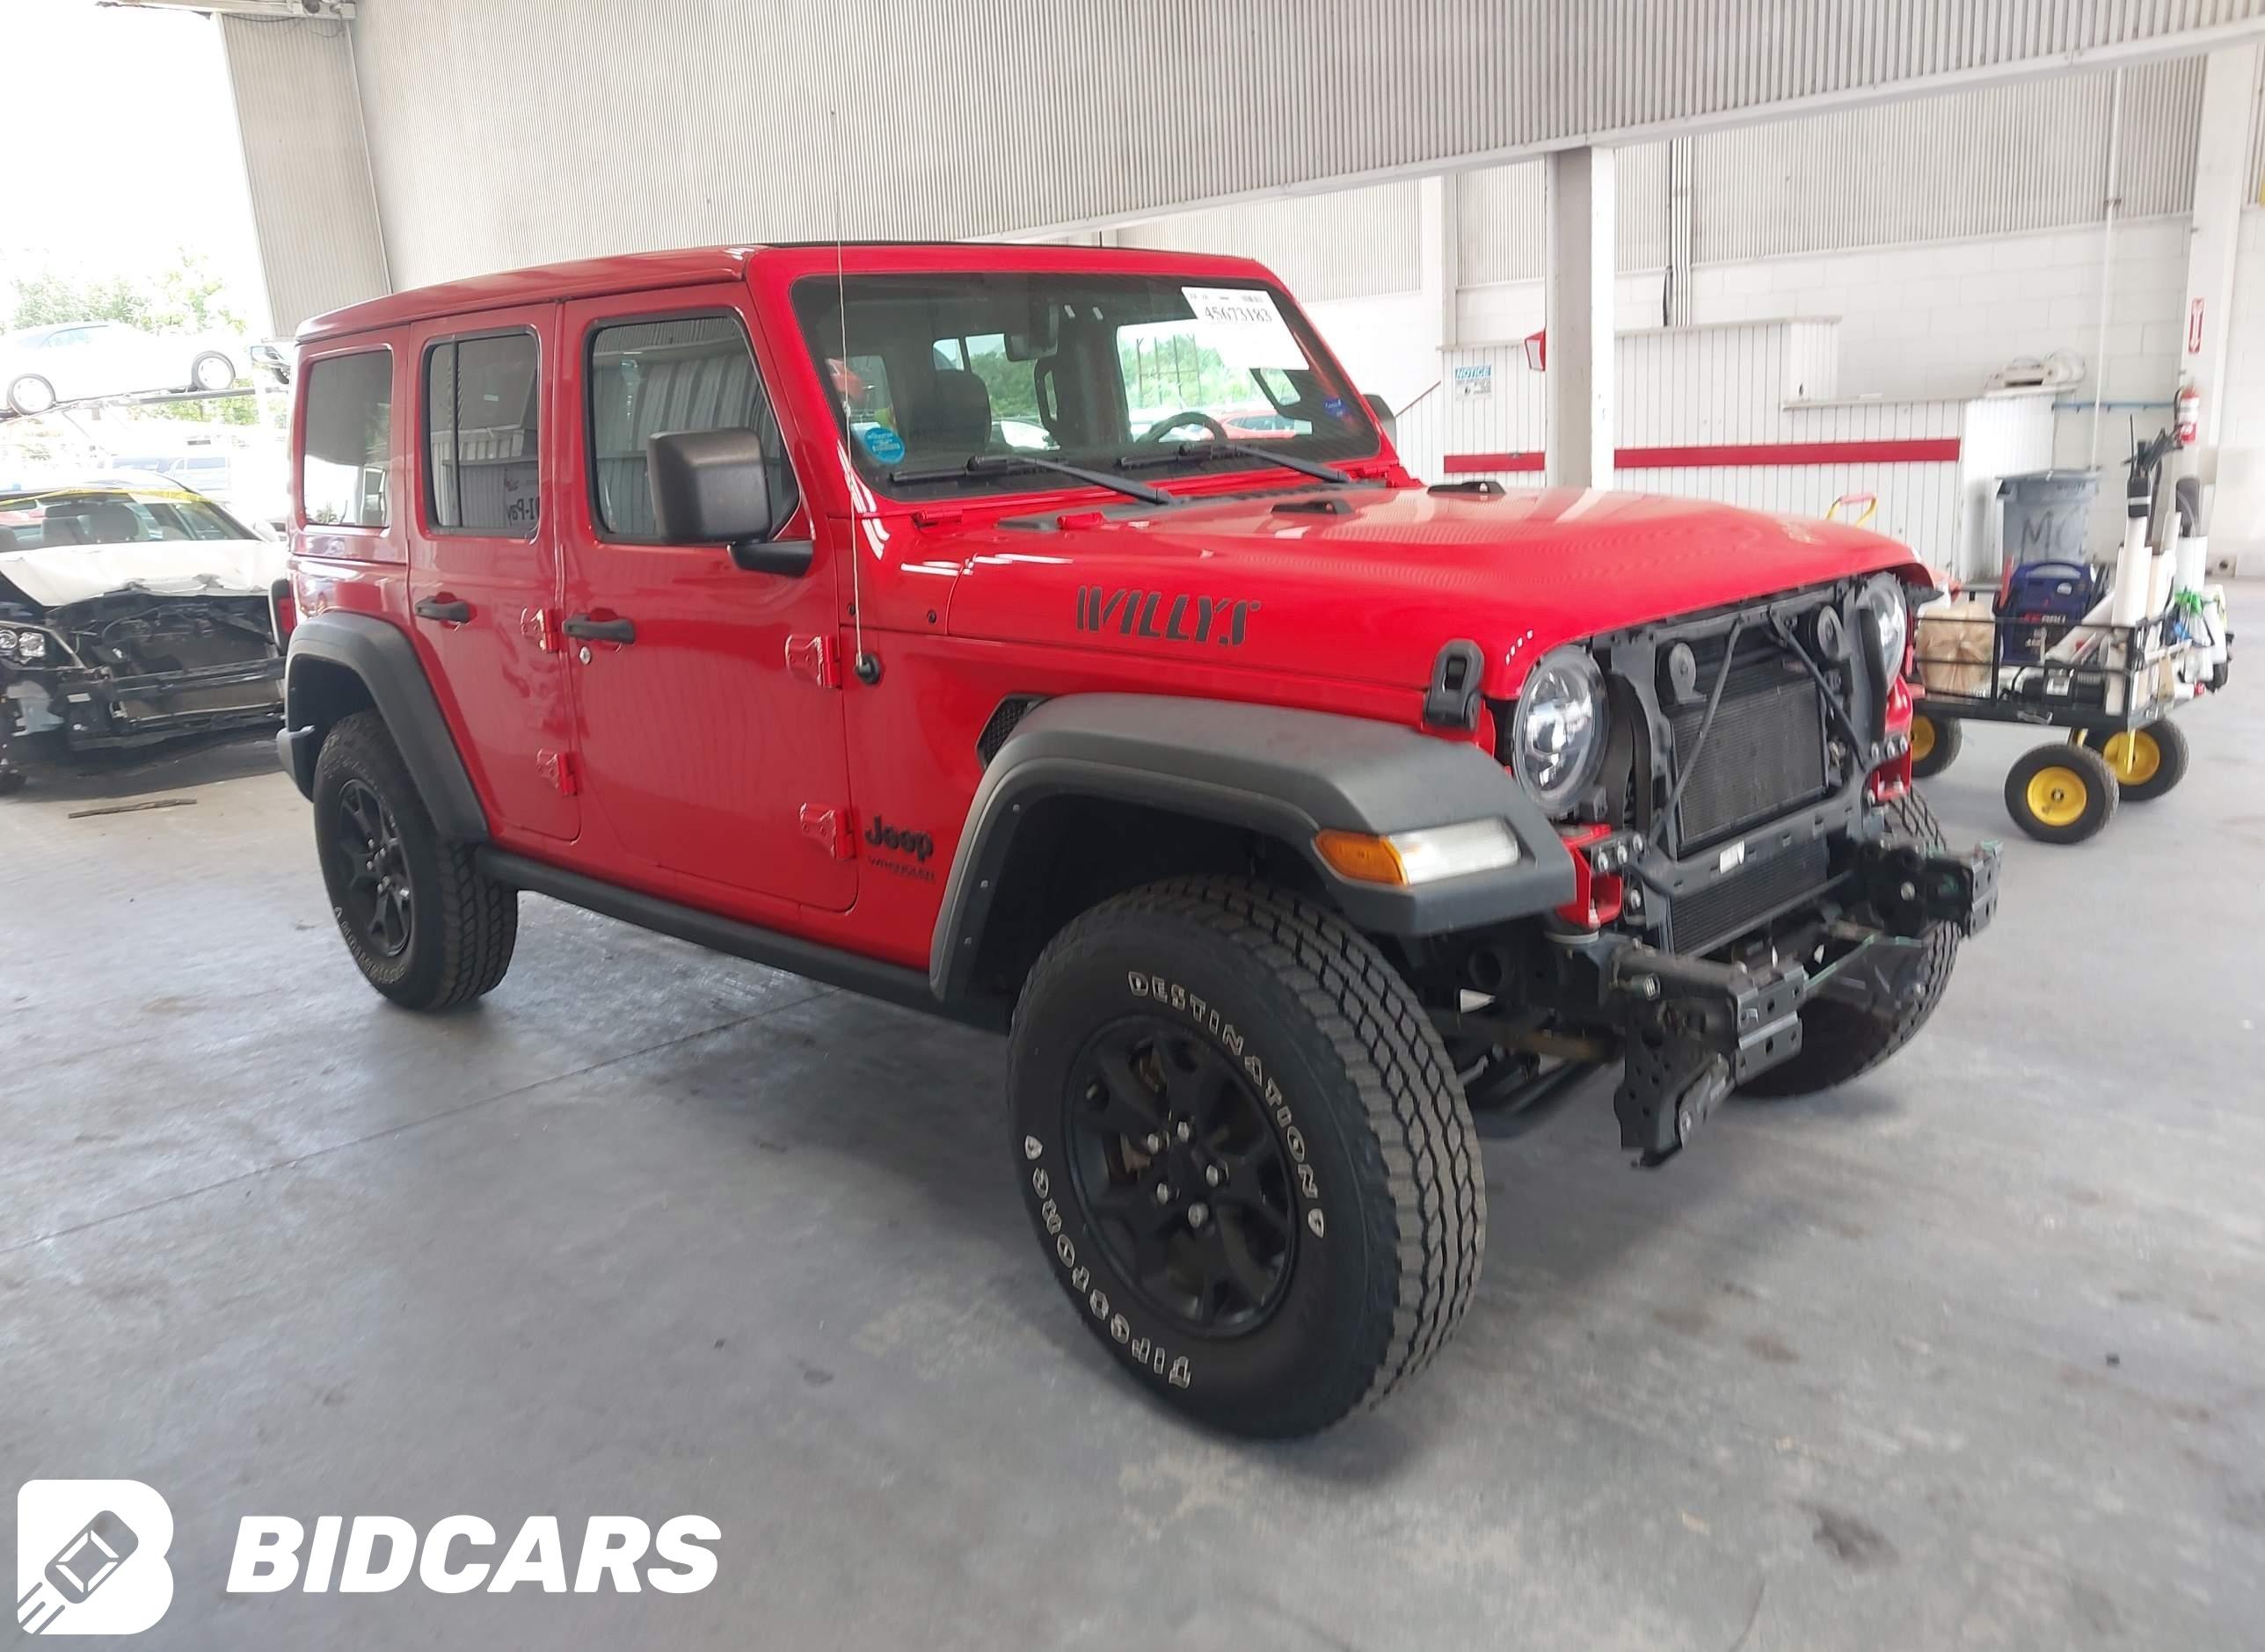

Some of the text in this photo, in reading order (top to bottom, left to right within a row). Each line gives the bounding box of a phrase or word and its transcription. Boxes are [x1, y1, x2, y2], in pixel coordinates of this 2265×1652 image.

[1077, 586, 1262, 647] WILLYS
[865, 815, 934, 862] Jeep
[1127, 971, 1319, 1199] DESTINATION
